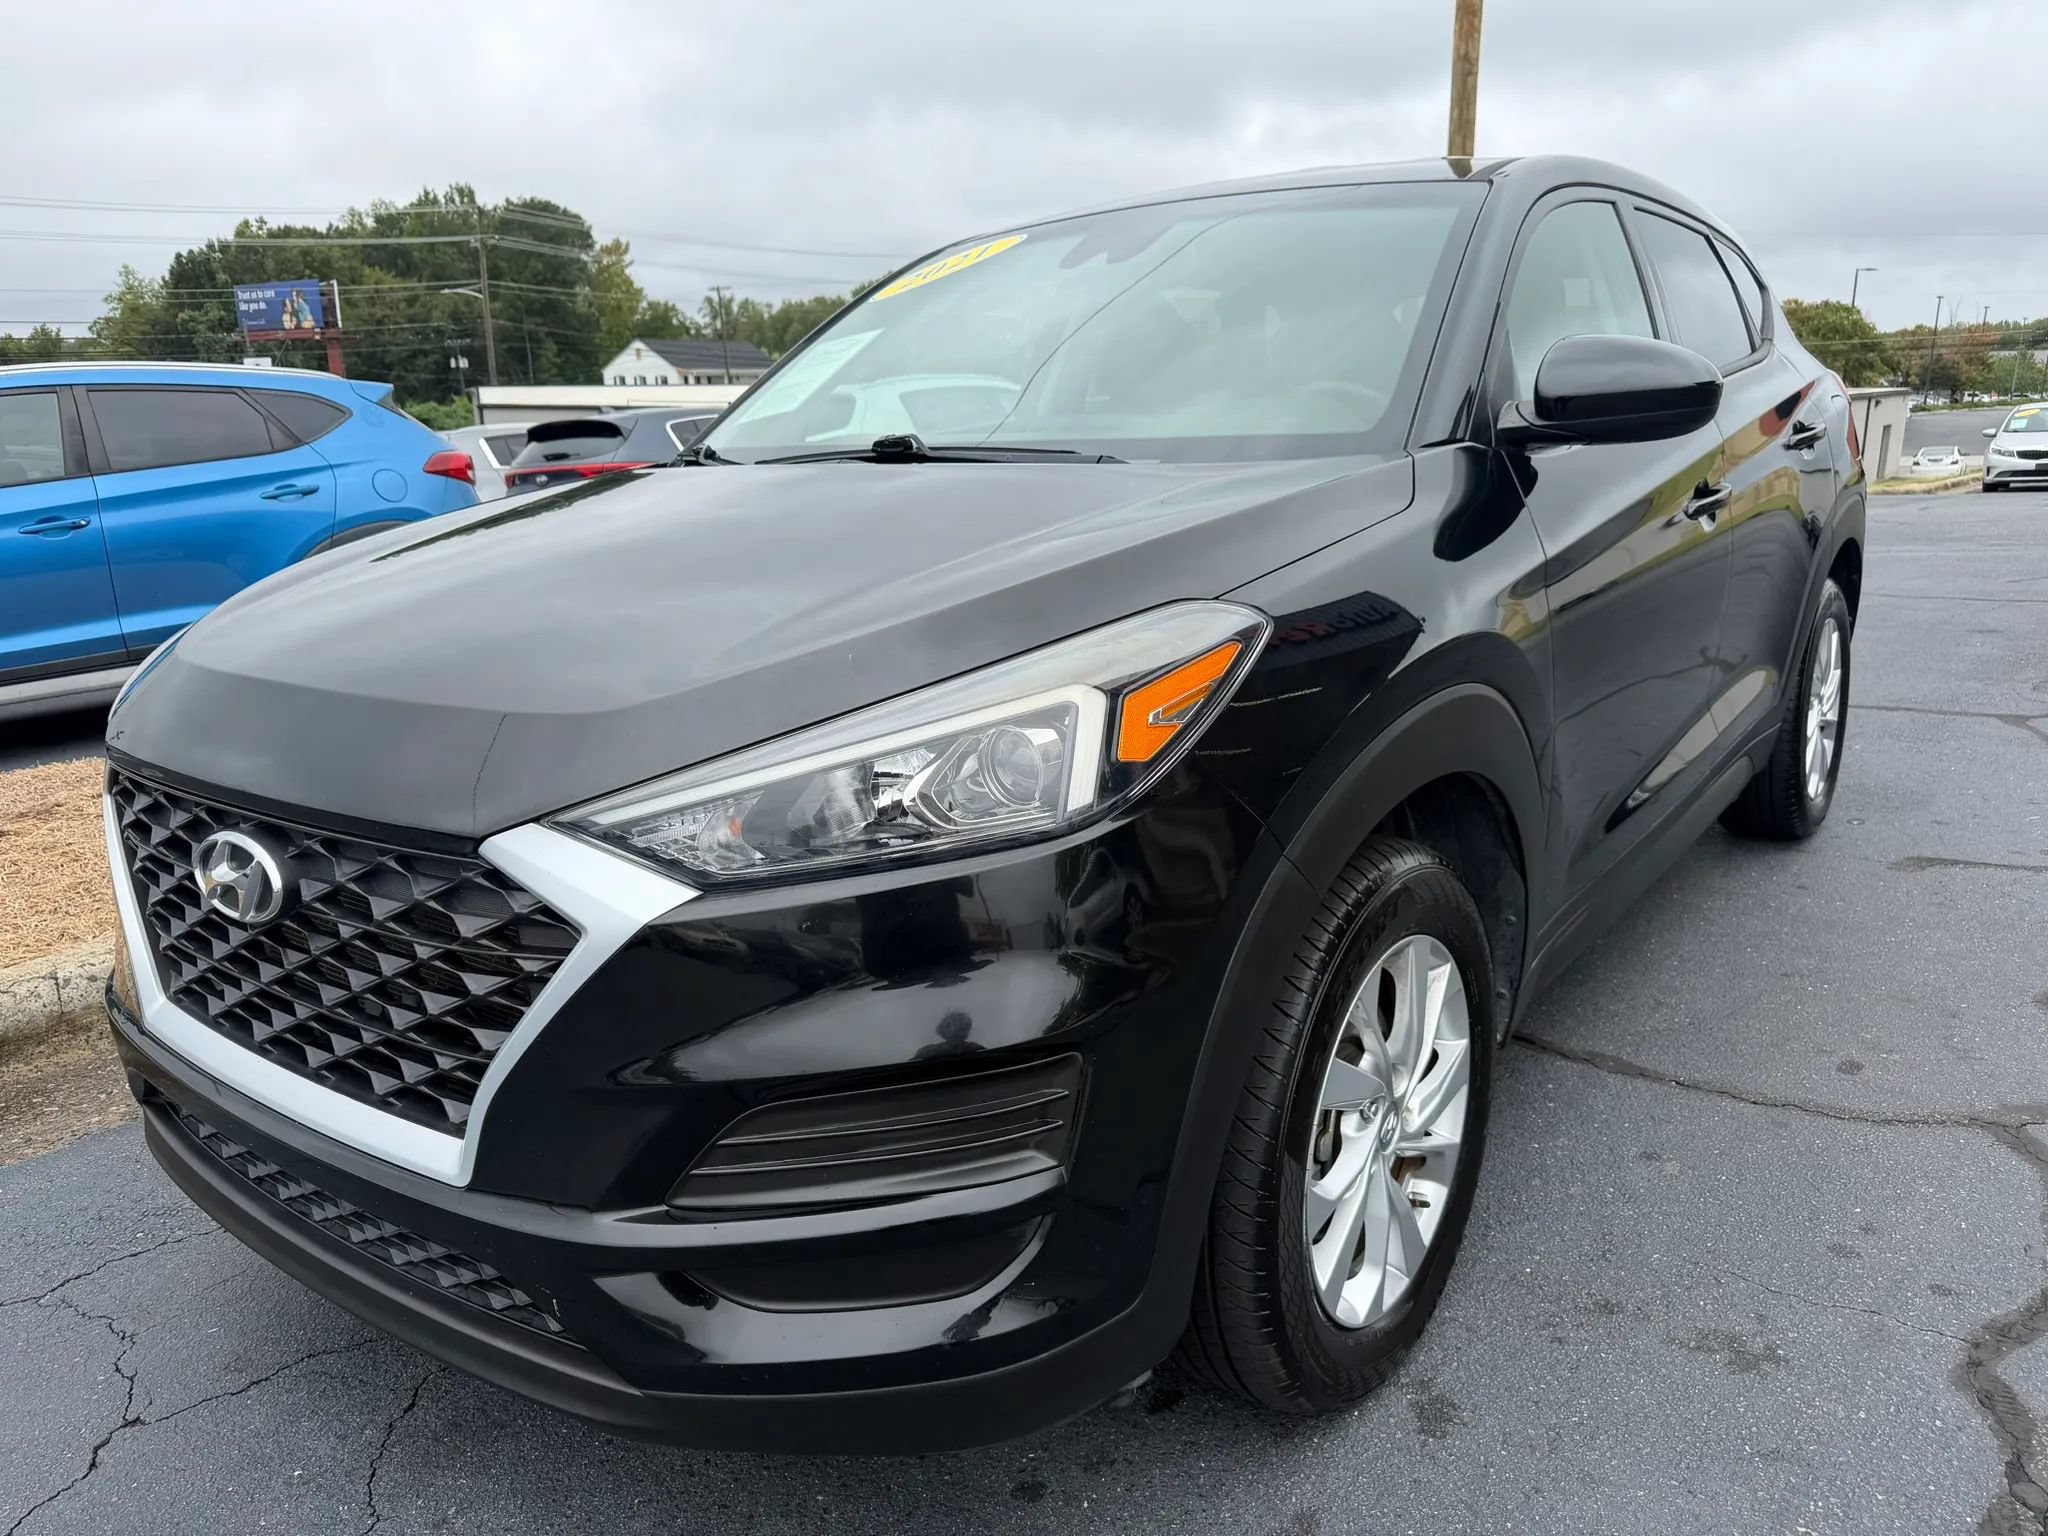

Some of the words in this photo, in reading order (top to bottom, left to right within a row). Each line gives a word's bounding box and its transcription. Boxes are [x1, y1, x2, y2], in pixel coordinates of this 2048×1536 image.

[237, 290, 250, 299] Trust
[239, 301, 249, 311] like
[249, 303, 258, 313] you
